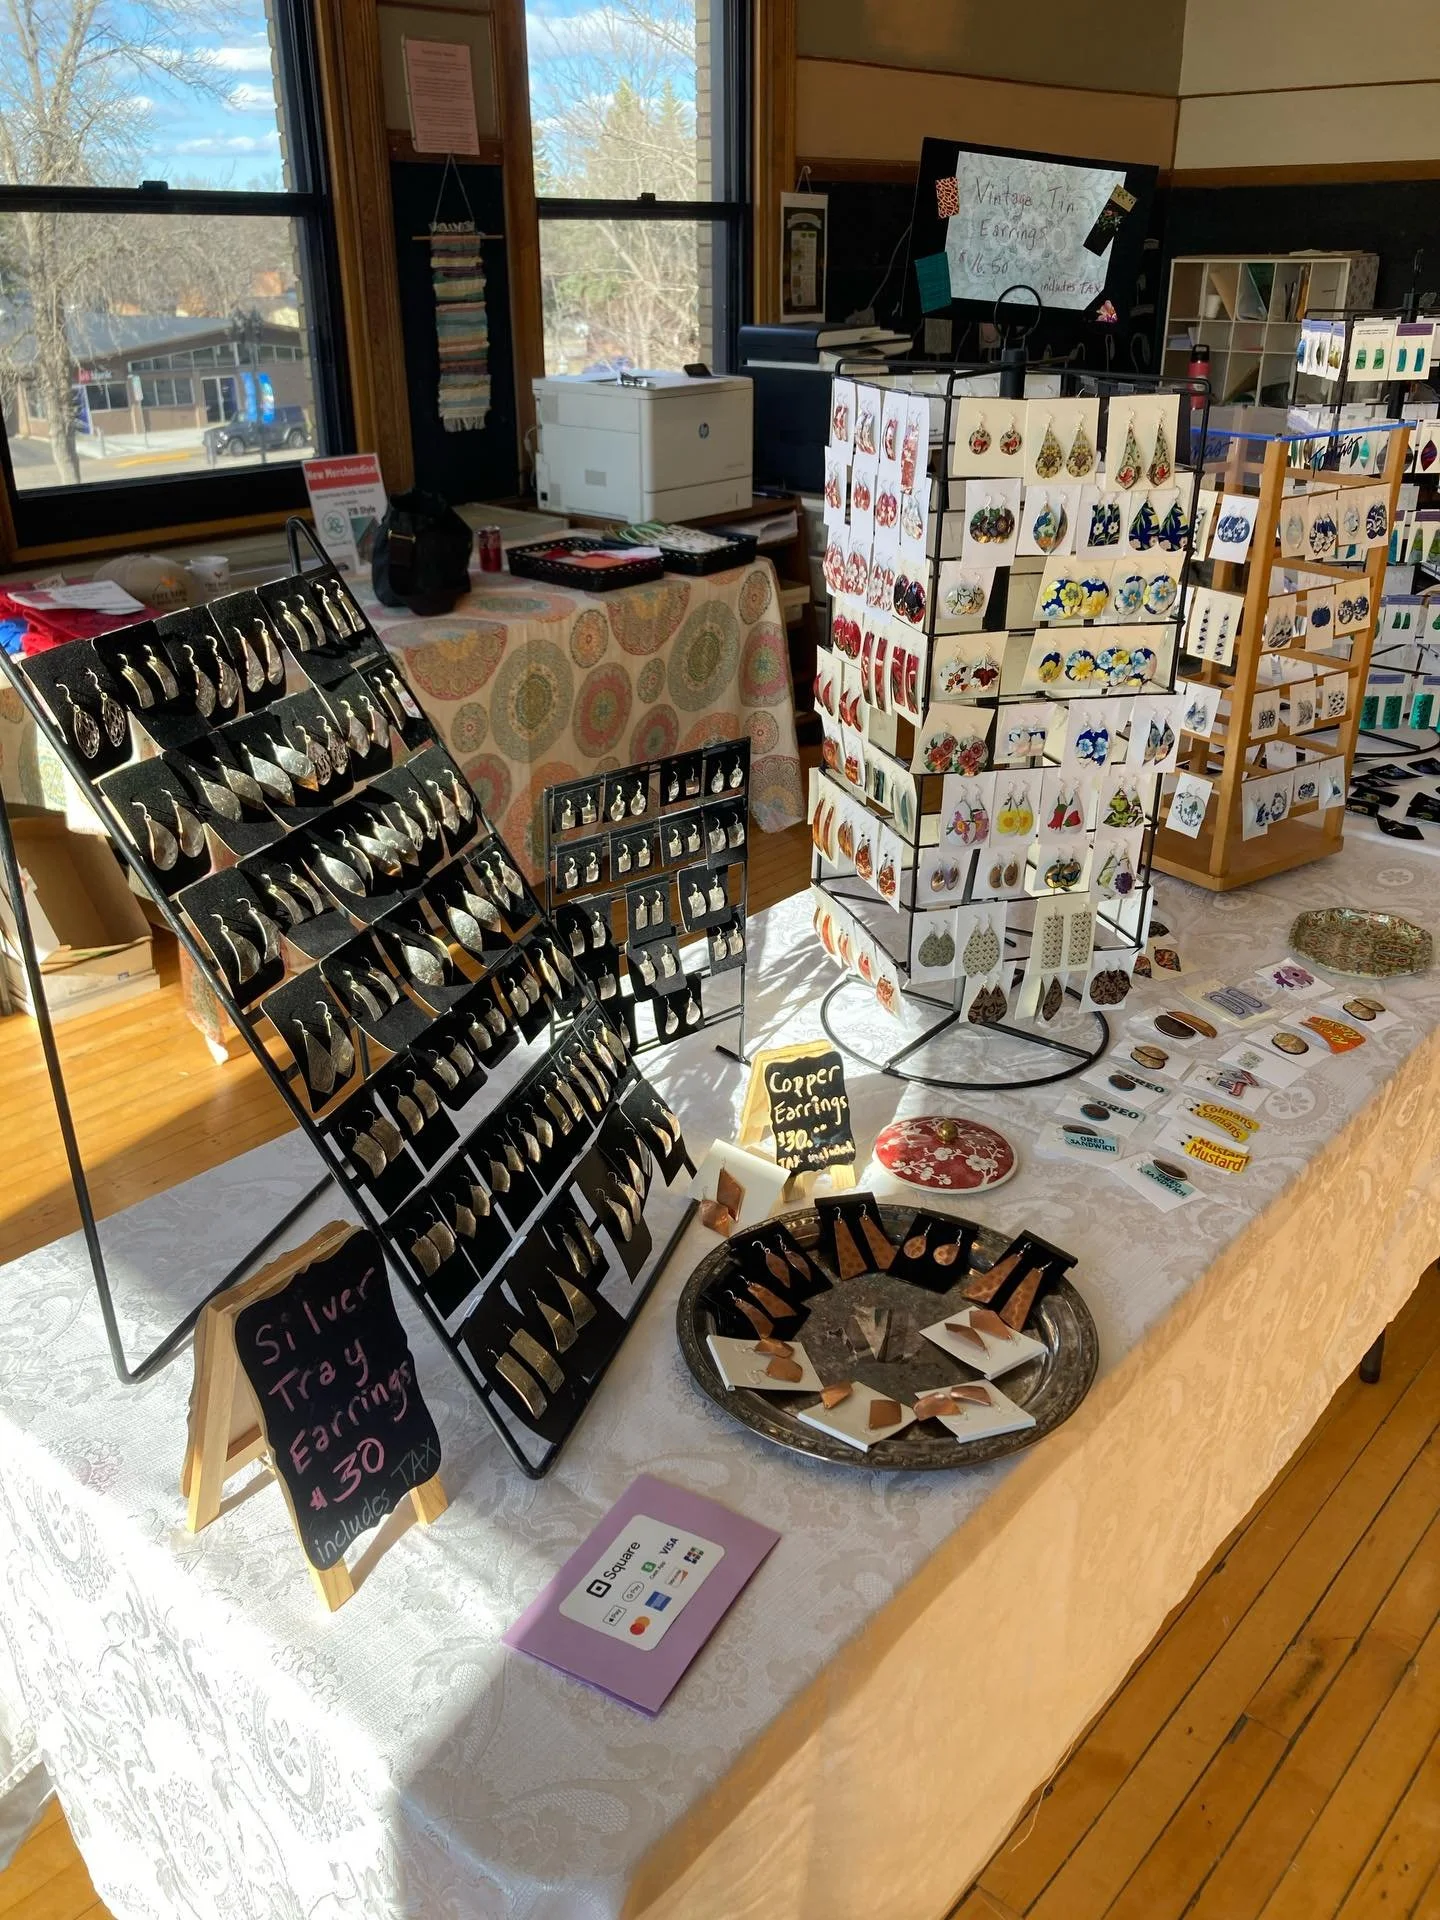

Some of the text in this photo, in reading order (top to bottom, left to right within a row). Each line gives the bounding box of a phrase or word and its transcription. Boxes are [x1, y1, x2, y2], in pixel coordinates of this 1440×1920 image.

[975, 177, 1077, 213] Vintage Tin
[979, 218, 1049, 250] Earrings
[1041, 277, 1076, 294] includes
[769, 1065, 840, 1098] Copper
[774, 1095, 847, 1125] Earrings
[1097, 1100, 1139, 1119] OREO
[1070, 1139, 1116, 1152] SANDWICH
[1080, 1136, 1105, 1145] OREO
[1189, 1142, 1244, 1172] Mustard
[255, 1267, 375, 1366] Silver
[268, 1338, 369, 1412] Tray
[289, 1360, 412, 1475] Earrings
[314, 1437, 440, 1564] includes TAX
[603, 1542, 641, 1581] Square
[659, 1538, 679, 1555] VISA
